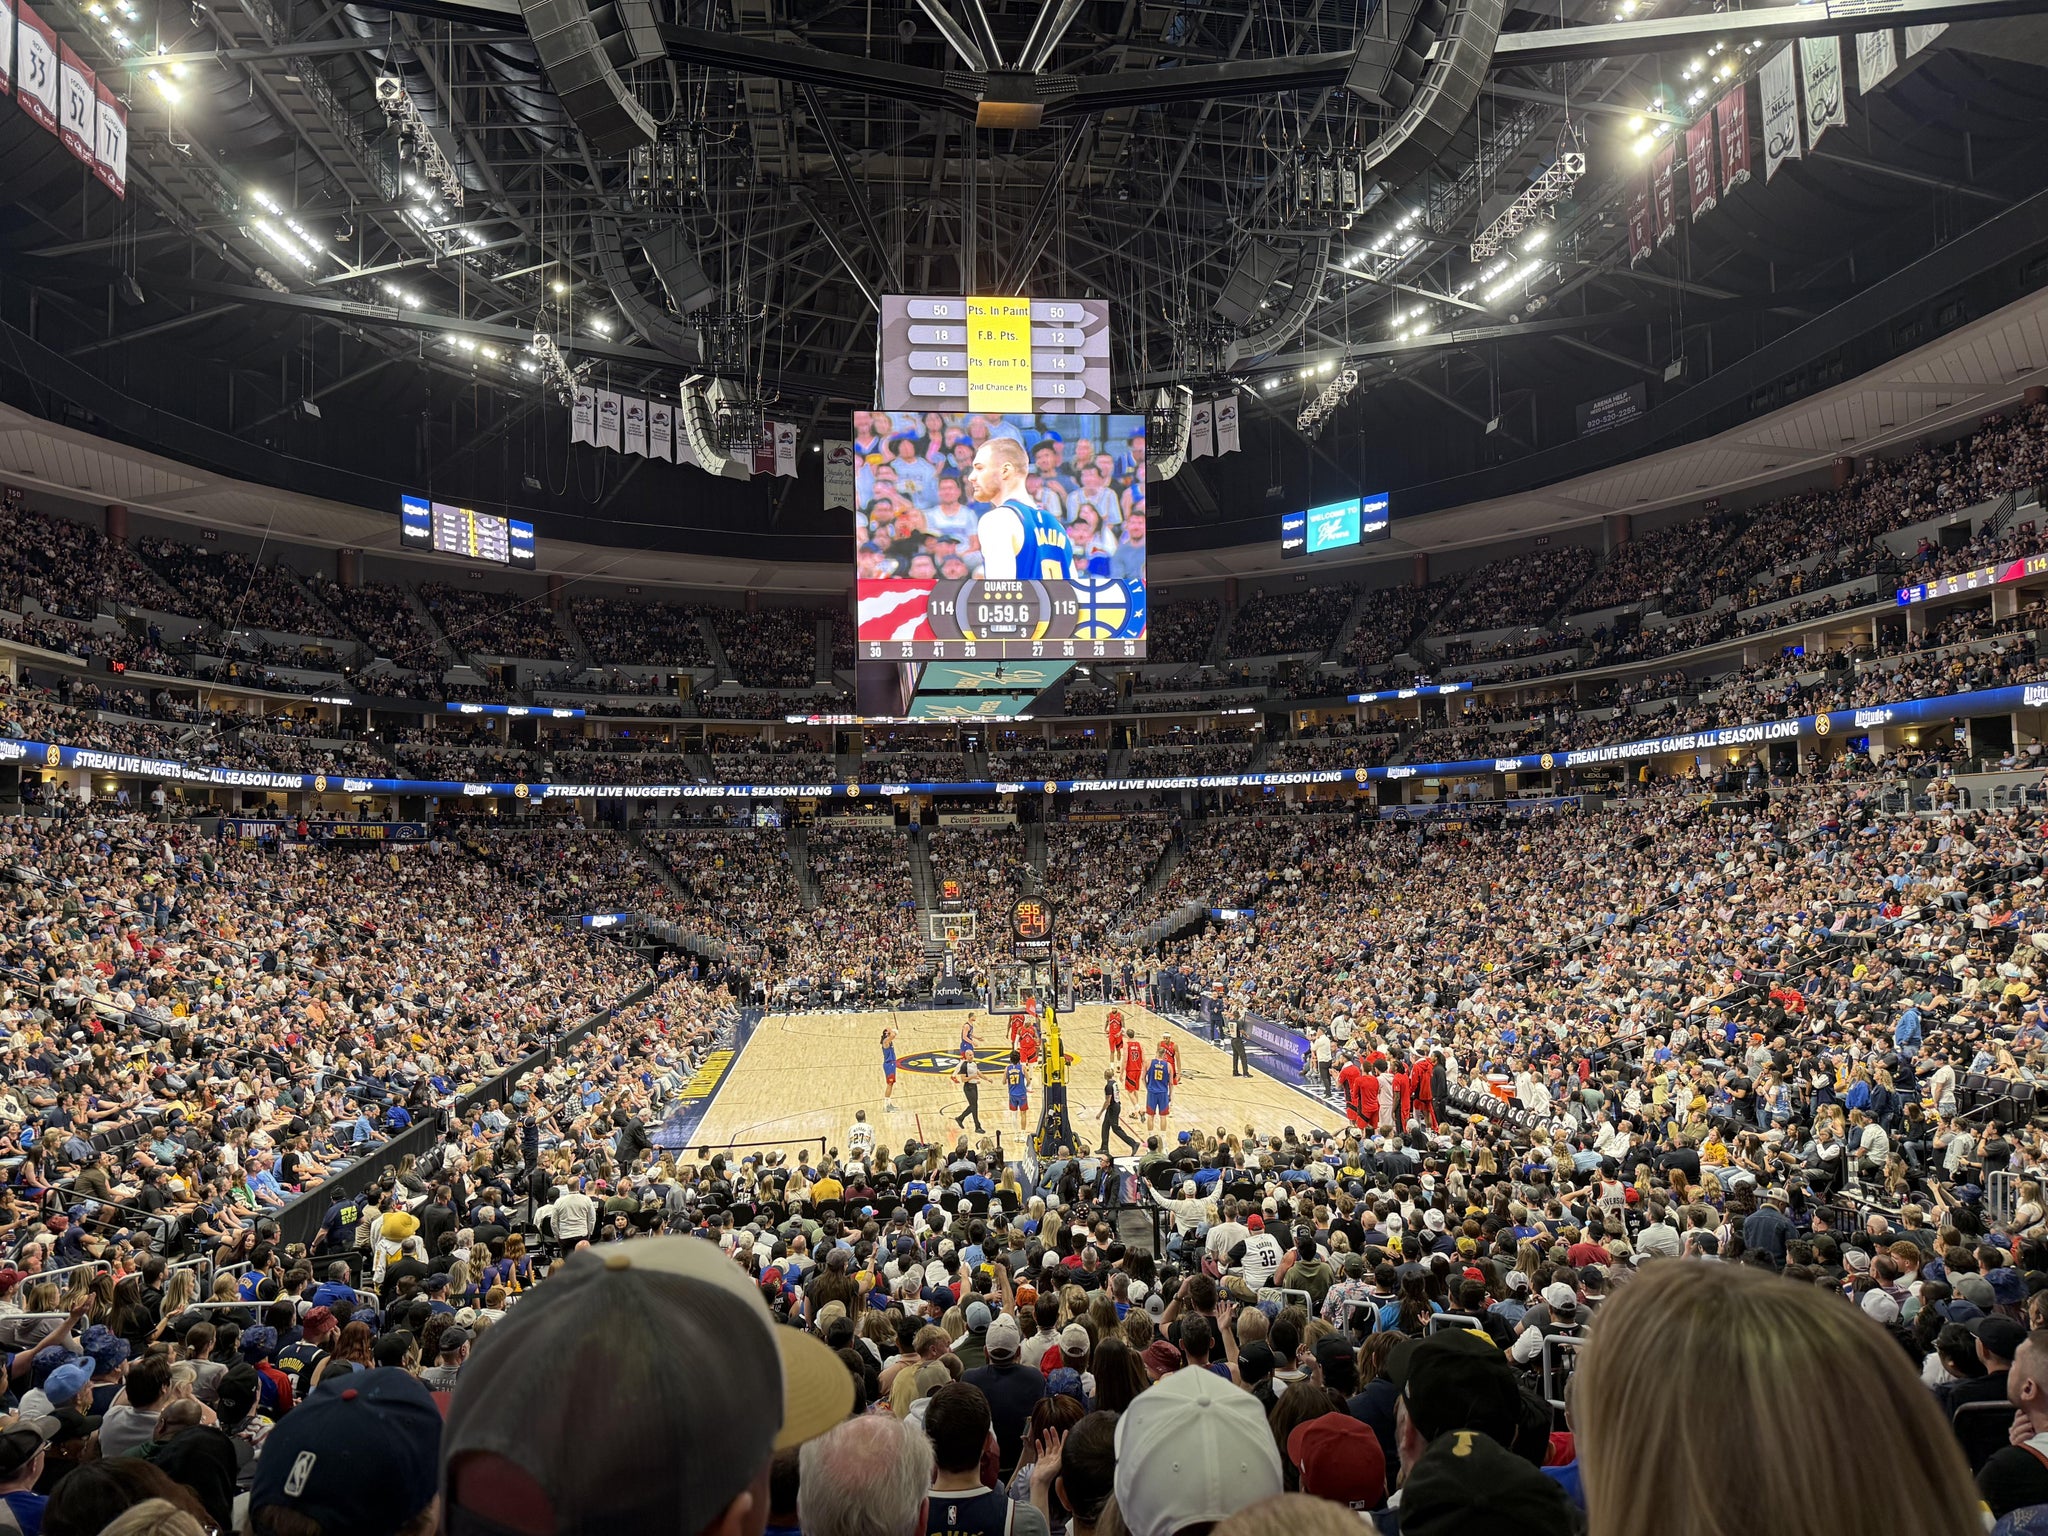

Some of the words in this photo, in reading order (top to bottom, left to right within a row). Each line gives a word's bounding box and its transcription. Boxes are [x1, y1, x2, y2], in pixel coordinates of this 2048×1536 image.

[30, 49, 45, 89] 33
[1812, 64, 1830, 80] NLL
[71, 88, 84, 127] 52
[1771, 97, 1788, 114] NLL
[1766, 100, 1795, 126] CHAMPIONS
[105, 123, 119, 162] 77
[1728, 141, 1741, 167] 24
[1695, 169, 1710, 195] 22
[1663, 199, 1670, 218] 9
[933, 305, 948, 315] 50
[968, 306, 986, 315] Pts.
[990, 306, 999, 315] In
[1003, 306, 1028, 316] Paint
[1050, 308, 1064, 318] 50
[935, 330, 948, 341] 18
[978, 331, 996, 340] F.B.
[1000, 331, 1018, 341] Pts.
[1052, 333, 1064, 343] 12
[935, 356, 949, 366] 15
[989, 358, 1011, 367] From
[1052, 358, 1065, 368] 14
[938, 382, 946, 392] 8
[970, 383, 984, 391] 2nd
[1053, 384, 1065, 394] 16
[1593, 398, 1612, 409] ARENA
[1310, 509, 1346, 522] WELCOME
[1348, 506, 1357, 515] TO
[2026, 557, 2048, 573] 114
[984, 581, 1022, 592] QUARTER
[1949, 584, 1958, 593] 33
[1989, 575, 1994, 584] 5
[931, 601, 954, 616] 114
[1054, 600, 1076, 615] 115
[978, 604, 1029, 623] 0:59.6
[981, 627, 987, 638] 5
[1020, 627, 1027, 638] 3
[870, 647, 881, 657] 30
[902, 647, 913, 657] 23
[933, 647, 944, 657] 41
[965, 646, 976, 656] 20
[1032, 646, 1043, 656] 27
[1063, 646, 1074, 656] 30
[1094, 646, 1105, 656] 28
[1124, 646, 1135, 656] 30
[1567, 751, 1598, 765] STREAM
[1599, 747, 1618, 761] LIVE
[1619, 741, 1660, 758] NUGGETS
[1662, 735, 1695, 752] GAMES
[1697, 732, 1717, 749] ALL
[1718, 725, 1763, 745] SEASON
[1765, 721, 1799, 739] LONG
[75, 751, 117, 770] STREAM
[118, 758, 139, 772] LIVE
[141, 760, 180, 778] NUGGETS
[211, 770, 224, 783] ALL
[226, 772, 271, 786] SEASON
[272, 774, 302, 788] LONG
[1072, 781, 1117, 792] STREAM
[1119, 780, 1144, 790] LIVE
[1147, 778, 1198, 789] NUGGETS
[1200, 776, 1238, 788] GAMES
[1240, 775, 1263, 786] ALL
[1264, 773, 1311, 785] SEASON
[1312, 771, 1342, 783] LONG
[546, 786, 595, 797] STREAM
[597, 786, 622, 797] LIVE
[625, 786, 680, 797] NUGGETS
[683, 786, 724, 797] GAMES
[726, 786, 749, 797] ALL
[751, 786, 797, 796] SEASON
[799, 786, 832, 796] LONG
[858, 818, 883, 826] SUITES
[944, 888, 959, 898] 24
[1018, 904, 1040, 915] 59.6
[1020, 915, 1046, 934] 24
[937, 987, 963, 997] xfinity
[1009, 1075, 1020, 1085] 27
[1154, 1069, 1163, 1081] 15
[1450, 1085, 1456, 1095] G
[1458, 1088, 1464, 1098] G
[1468, 1092, 1475, 1102] G
[1480, 1096, 1487, 1106] G
[1487, 1099, 1493, 1109] G
[1497, 1103, 1504, 1113] G
[1508, 1107, 1515, 1118] G
[1516, 1111, 1523, 1121] G
[1527, 1116, 1534, 1126] G
[1550, 1124, 1558, 1136] G
[853, 1133, 865, 1144] 27
[1260, 1250, 1276, 1267] 32
[279, 1358, 304, 1372] GORDON
